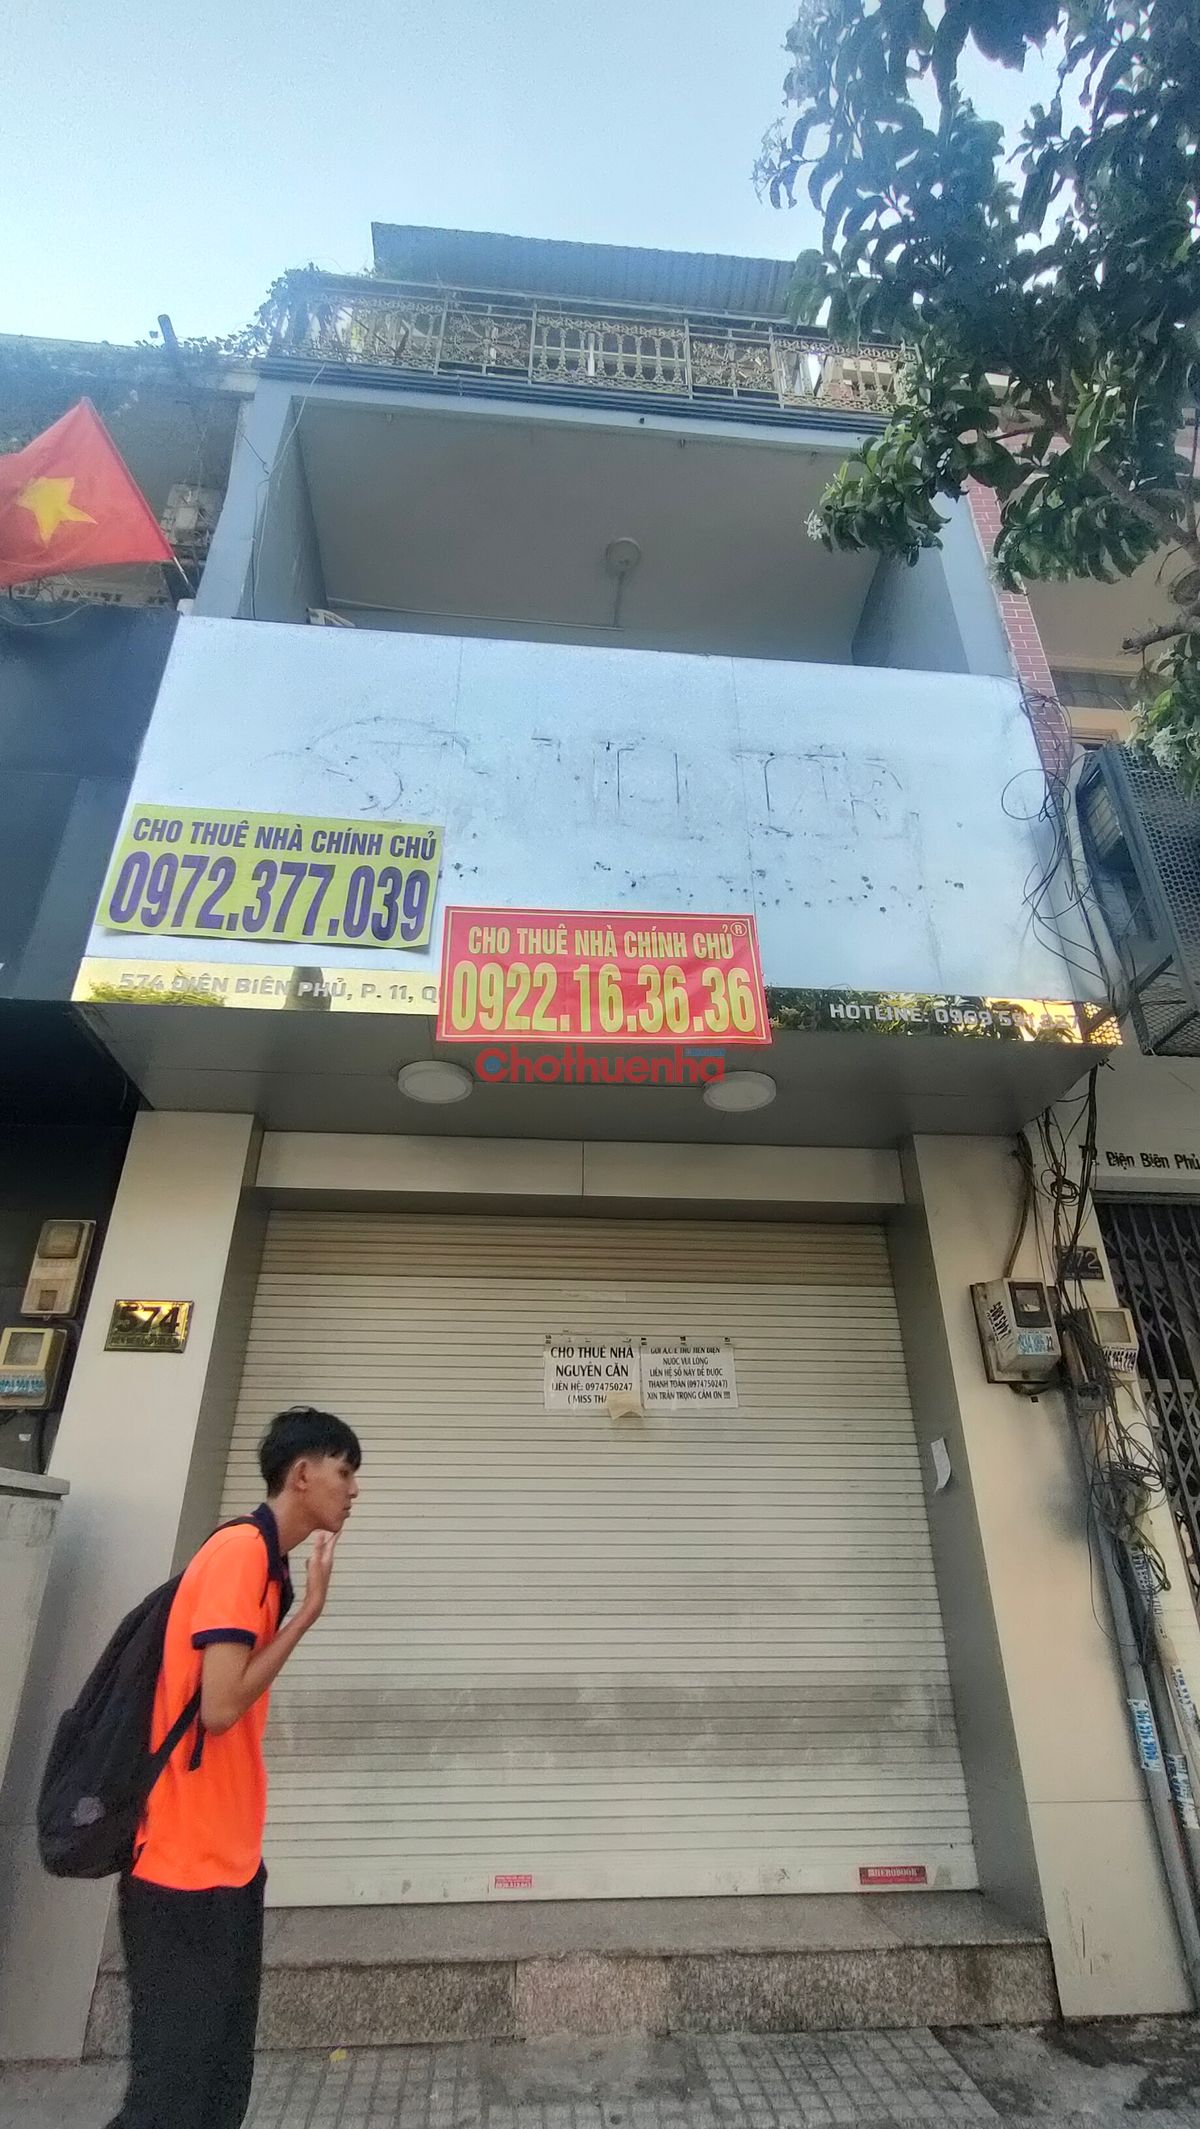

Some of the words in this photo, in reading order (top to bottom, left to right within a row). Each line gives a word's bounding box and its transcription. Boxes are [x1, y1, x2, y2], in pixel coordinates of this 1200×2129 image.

[133, 817, 183, 843] CHO
[190, 820, 250, 848] THUÊ
[254, 824, 303, 852] NHÀ
[311, 827, 384, 857] CHÍNH
[389, 831, 437, 861] CHỦ
[109, 851, 431, 943] 0972.377.039
[468, 926, 510, 955] CHO
[517, 923, 569, 956] THUÊ
[575, 924, 618, 959] NHÀ
[624, 926, 688, 959] CHÍNH
[693, 923, 735, 960] CHỦ
[120, 973, 165, 990] 574
[235, 976, 288, 995] BIÊN
[297, 978, 352, 1000] PHỦ,
[361, 983, 382, 999] P.
[389, 985, 414, 1003] 11,
[451, 960, 757, 1034] 0922.16.36.36
[830, 1003, 929, 1024] HOTLINE:
[1106, 1151, 1135, 1170] Điện
[1140, 1153, 1169, 1169] Biên
[1174, 1153, 1200, 1170] Phủ
[116, 1305, 180, 1333] 574
[550, 1346, 574, 1359] CHO
[578, 1344, 606, 1359] THUÊ
[610, 1345, 634, 1359] NHÀ
[555, 1361, 602, 1377] NGUYÊN
[605, 1362, 629, 1377] CĂN
[552, 1380, 568, 1391] LIÊN
[585, 1382, 633, 1392] 0974750247
[648, 1380, 668, 1389] THANH
